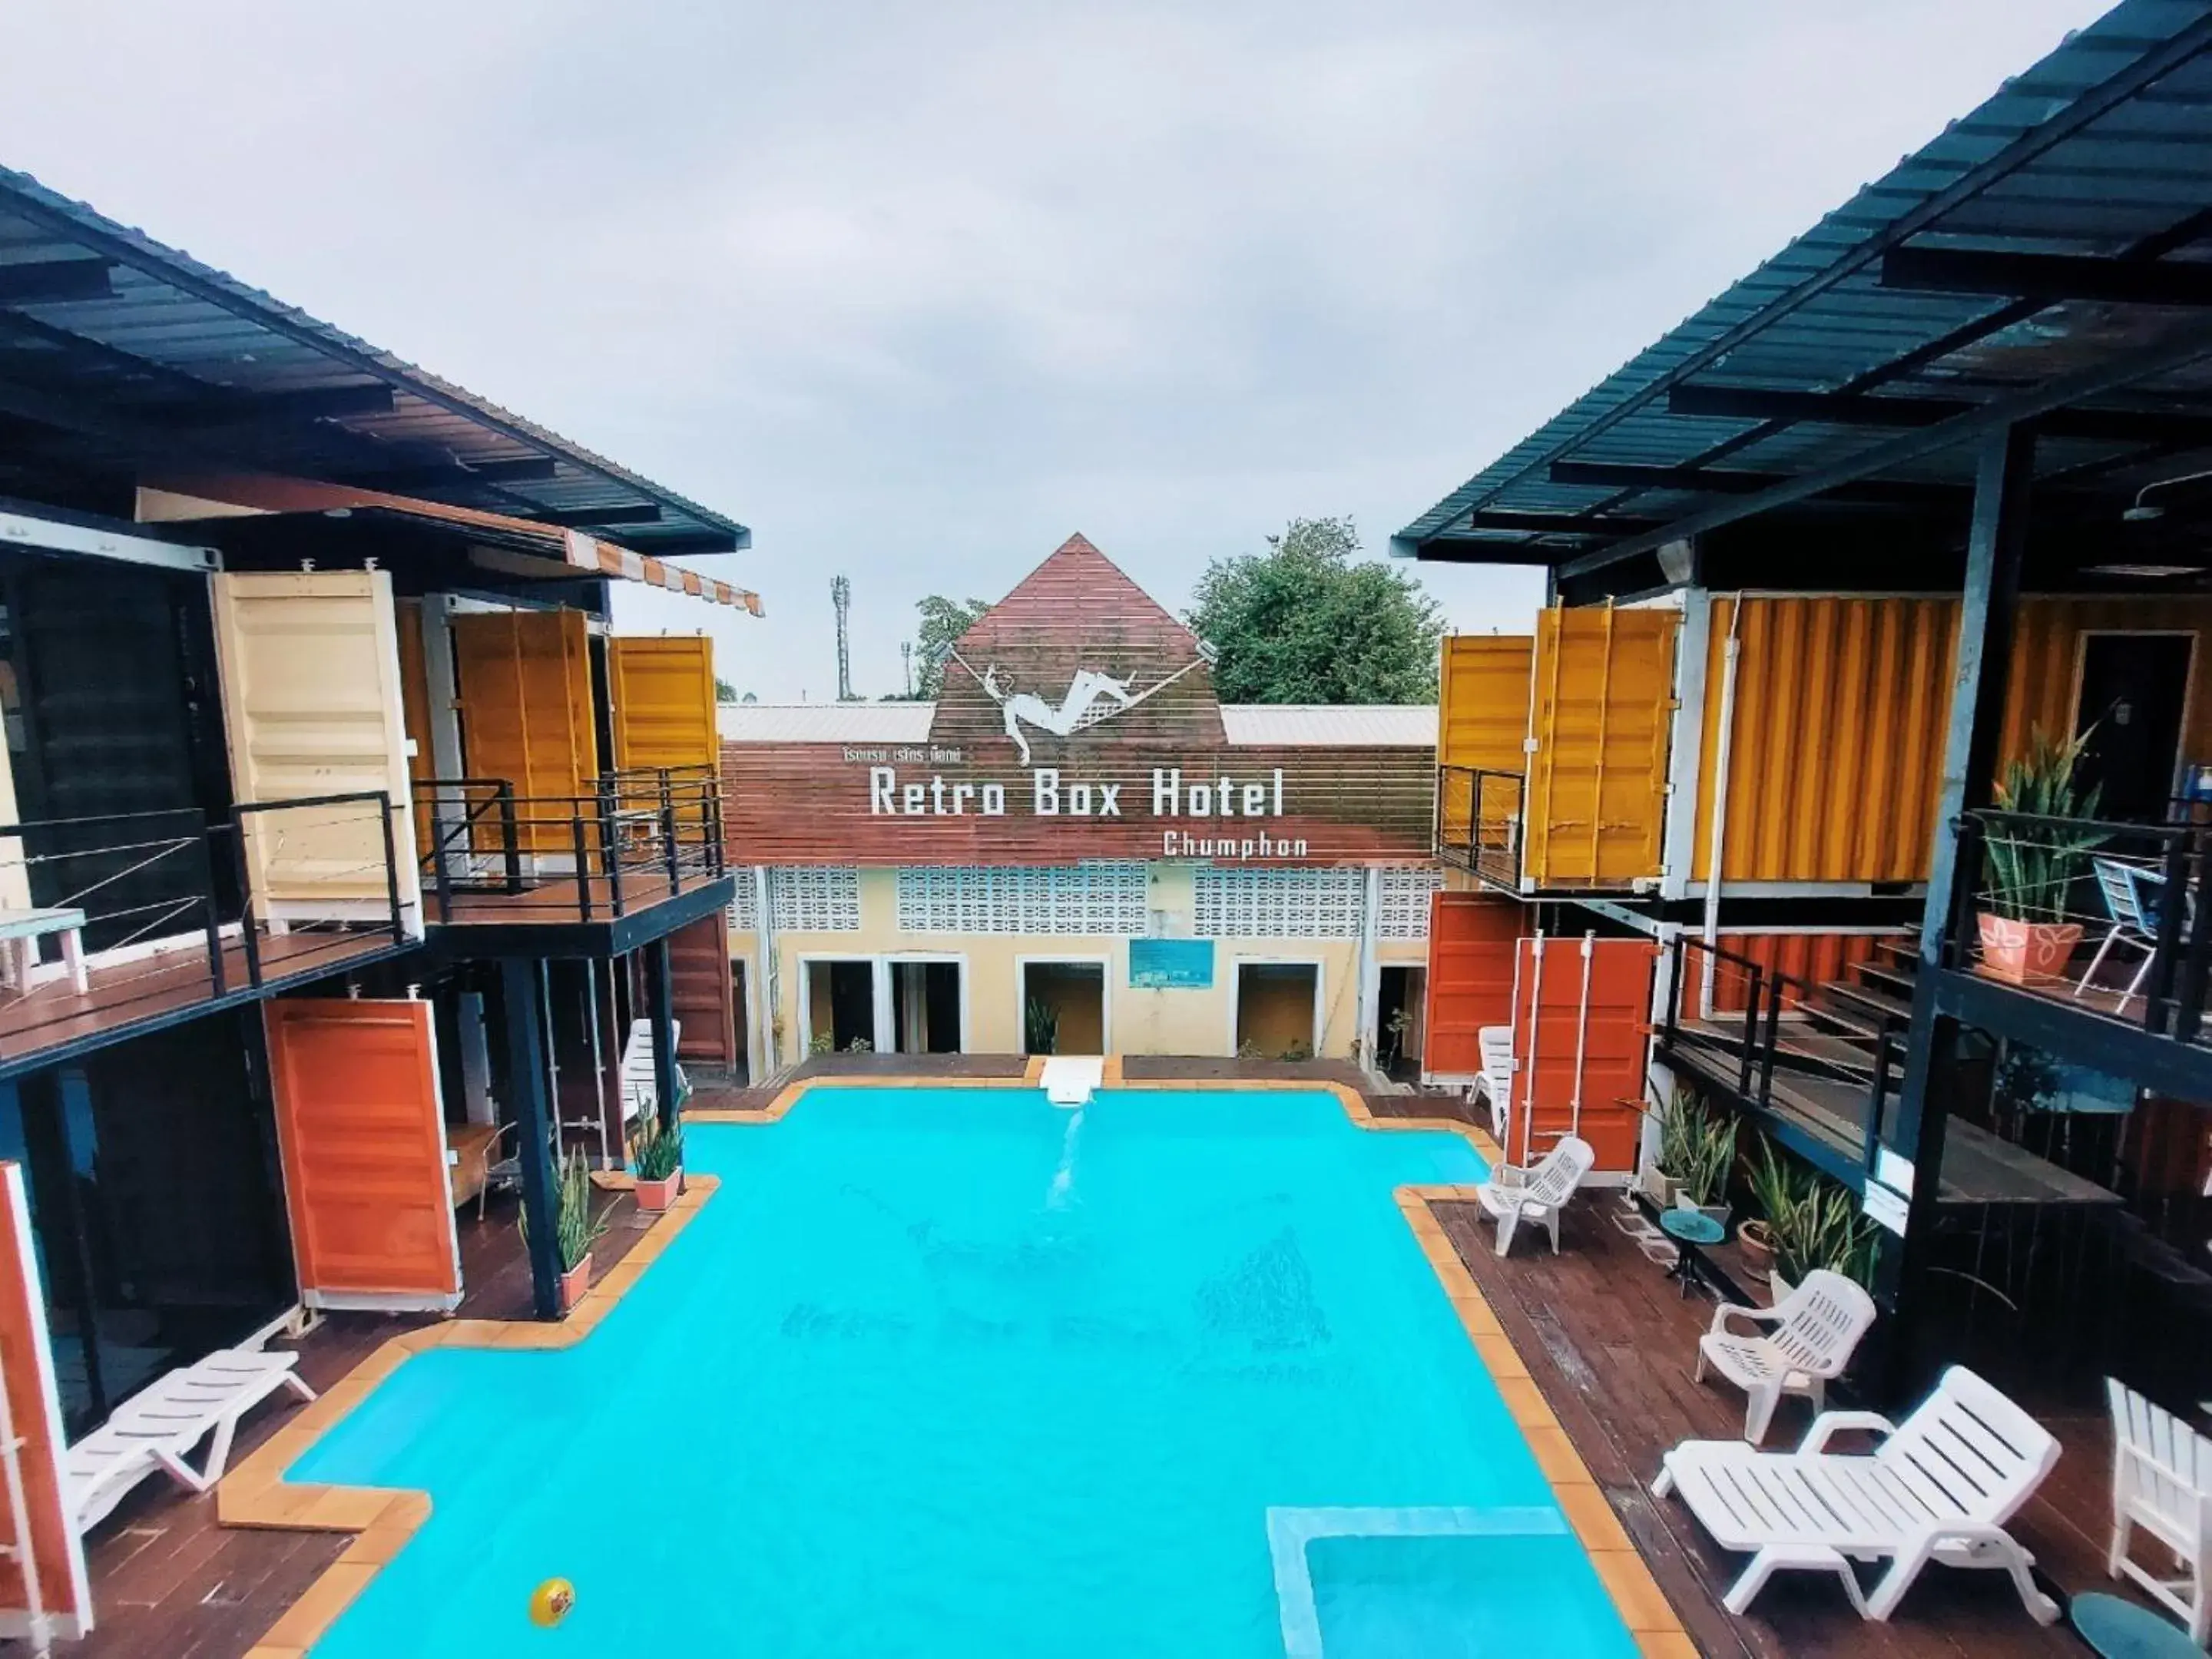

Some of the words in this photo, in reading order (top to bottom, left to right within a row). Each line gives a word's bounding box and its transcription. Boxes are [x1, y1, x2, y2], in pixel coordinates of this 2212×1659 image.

[870, 767, 1005, 816] Retro
[1035, 768, 1121, 816] Box
[1154, 768, 1282, 816] Hotel
[1164, 830, 1307, 860] Chumphon
